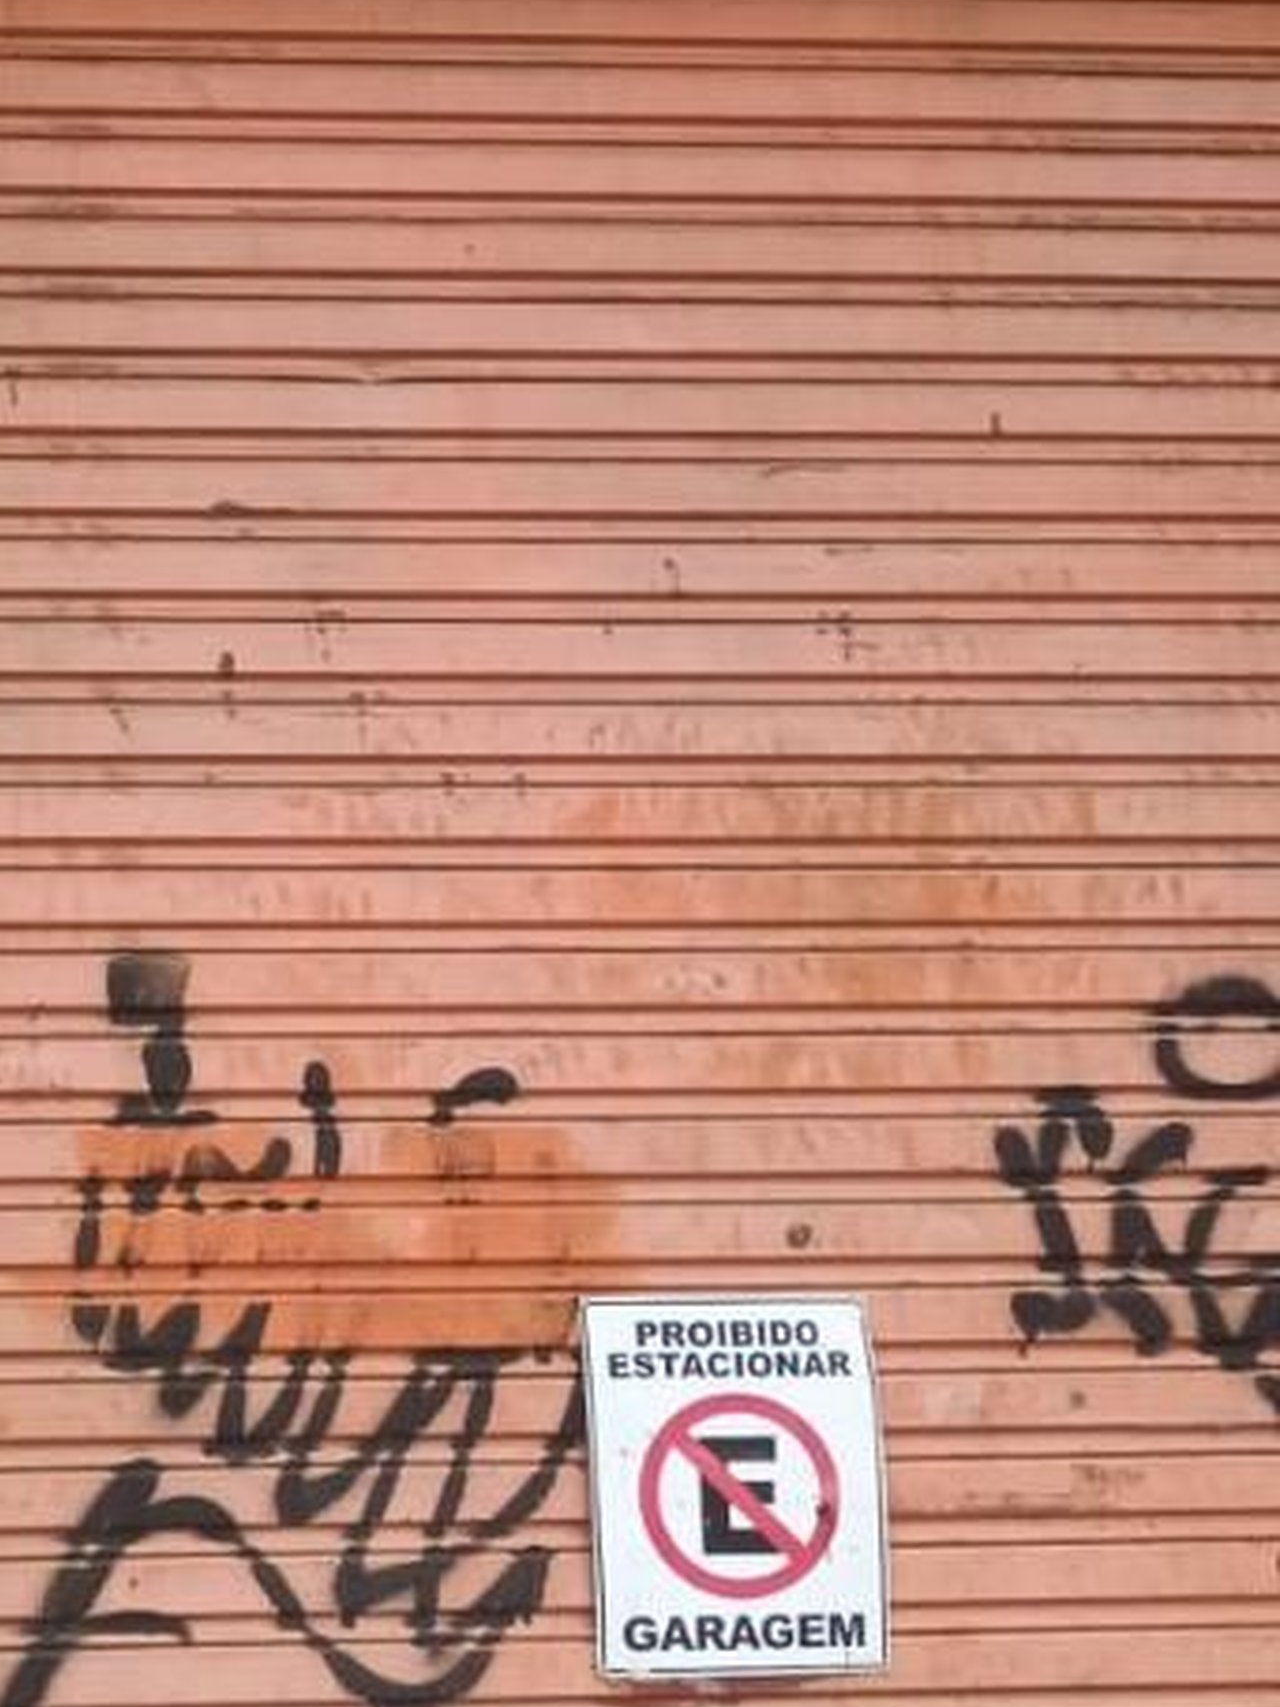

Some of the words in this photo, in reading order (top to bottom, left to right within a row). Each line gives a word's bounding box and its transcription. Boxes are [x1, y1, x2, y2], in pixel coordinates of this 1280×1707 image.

[635, 1320, 820, 1348] PROIBIDO
[608, 1351, 852, 1379] ESTACIONAR
[697, 1435, 783, 1555] E
[623, 1612, 867, 1652] GARAGEM
